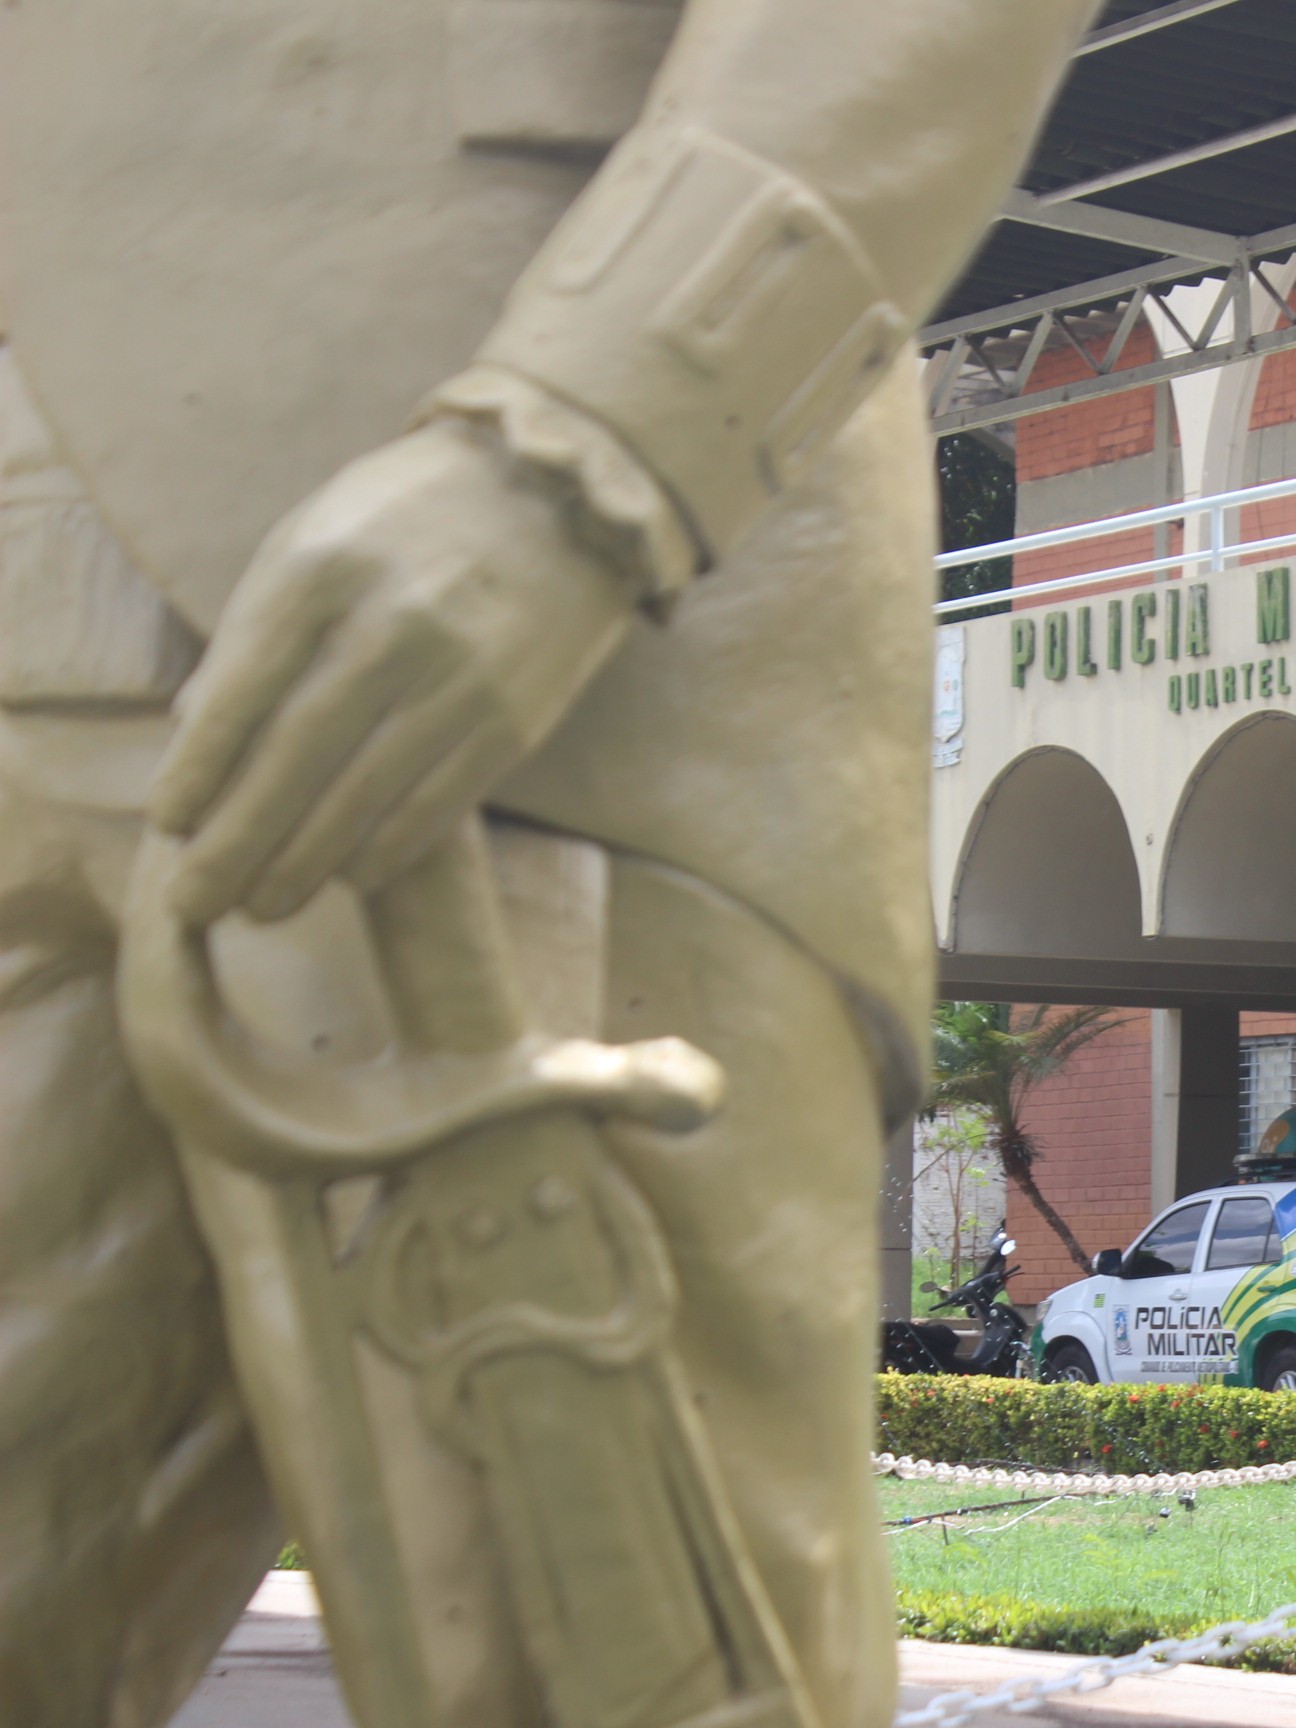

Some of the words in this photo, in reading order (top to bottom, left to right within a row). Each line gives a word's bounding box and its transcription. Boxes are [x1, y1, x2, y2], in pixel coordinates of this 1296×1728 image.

[1010, 582, 1210, 688] POLICIA
[1168, 657, 1291, 715] QUARTEL
[1147, 1332, 1238, 1356] MILITAR
